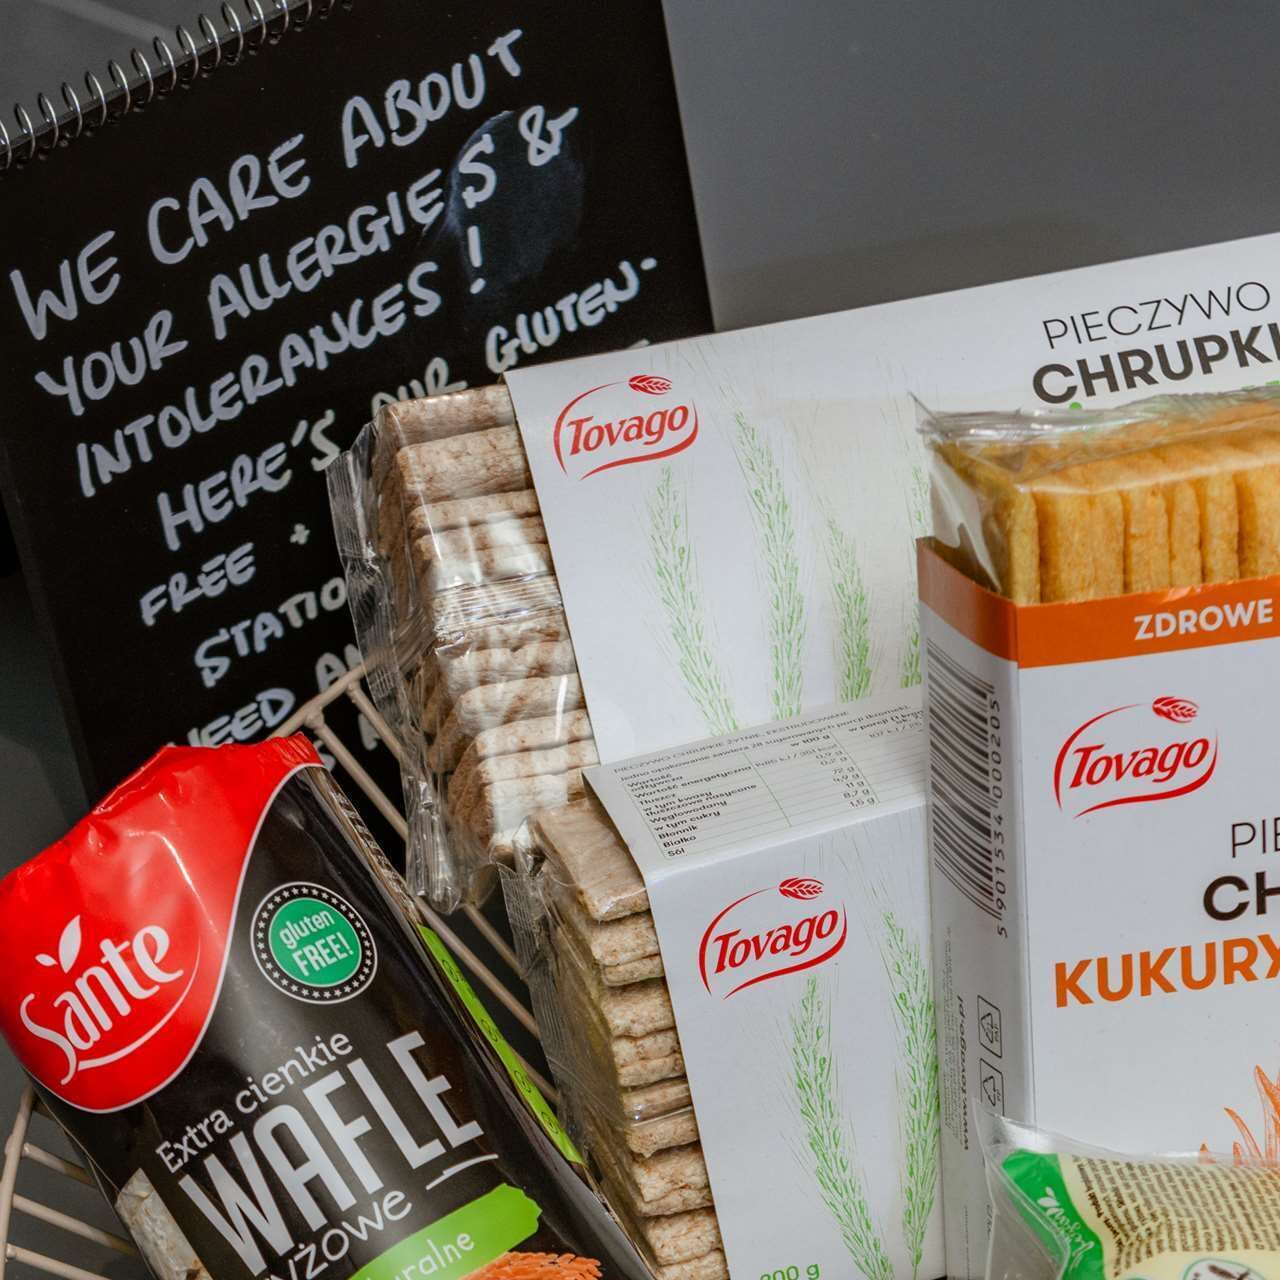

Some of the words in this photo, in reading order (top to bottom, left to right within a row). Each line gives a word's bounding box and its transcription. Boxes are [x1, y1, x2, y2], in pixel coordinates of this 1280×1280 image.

[9, 229, 121, 341] WE
[147, 133, 312, 265] CARE
[340, 28, 524, 168] ABOUT
[34, 308, 189, 417] YOUR
[207, 134, 497, 340] ALLERGIES
[519, 104, 579, 168] &
[1041, 281, 1271, 350] PIECZYWO
[75, 260, 443, 499] INTOLERANCES
[566, 404, 690, 457] Tovago
[155, 408, 341, 552] HERE'S
[138, 541, 258, 628] FREE
[193, 576, 349, 689] STATIO
[1132, 597, 1275, 641] ZDROWE
[989, 699, 1004, 800] 000205
[1068, 737, 1211, 789] Tovago
[992, 814, 1008, 912] 901534
[279, 909, 336, 950] gluten
[291, 931, 355, 977] FREE!
[712, 909, 839, 975] Tovago
[19, 924, 185, 1086] Sante
[155, 1107, 235, 1174] Extra
[234, 1032, 354, 1115] cienkie
[178, 1029, 485, 1278] WAFLE
[806, 1262, 820, 1280] g
